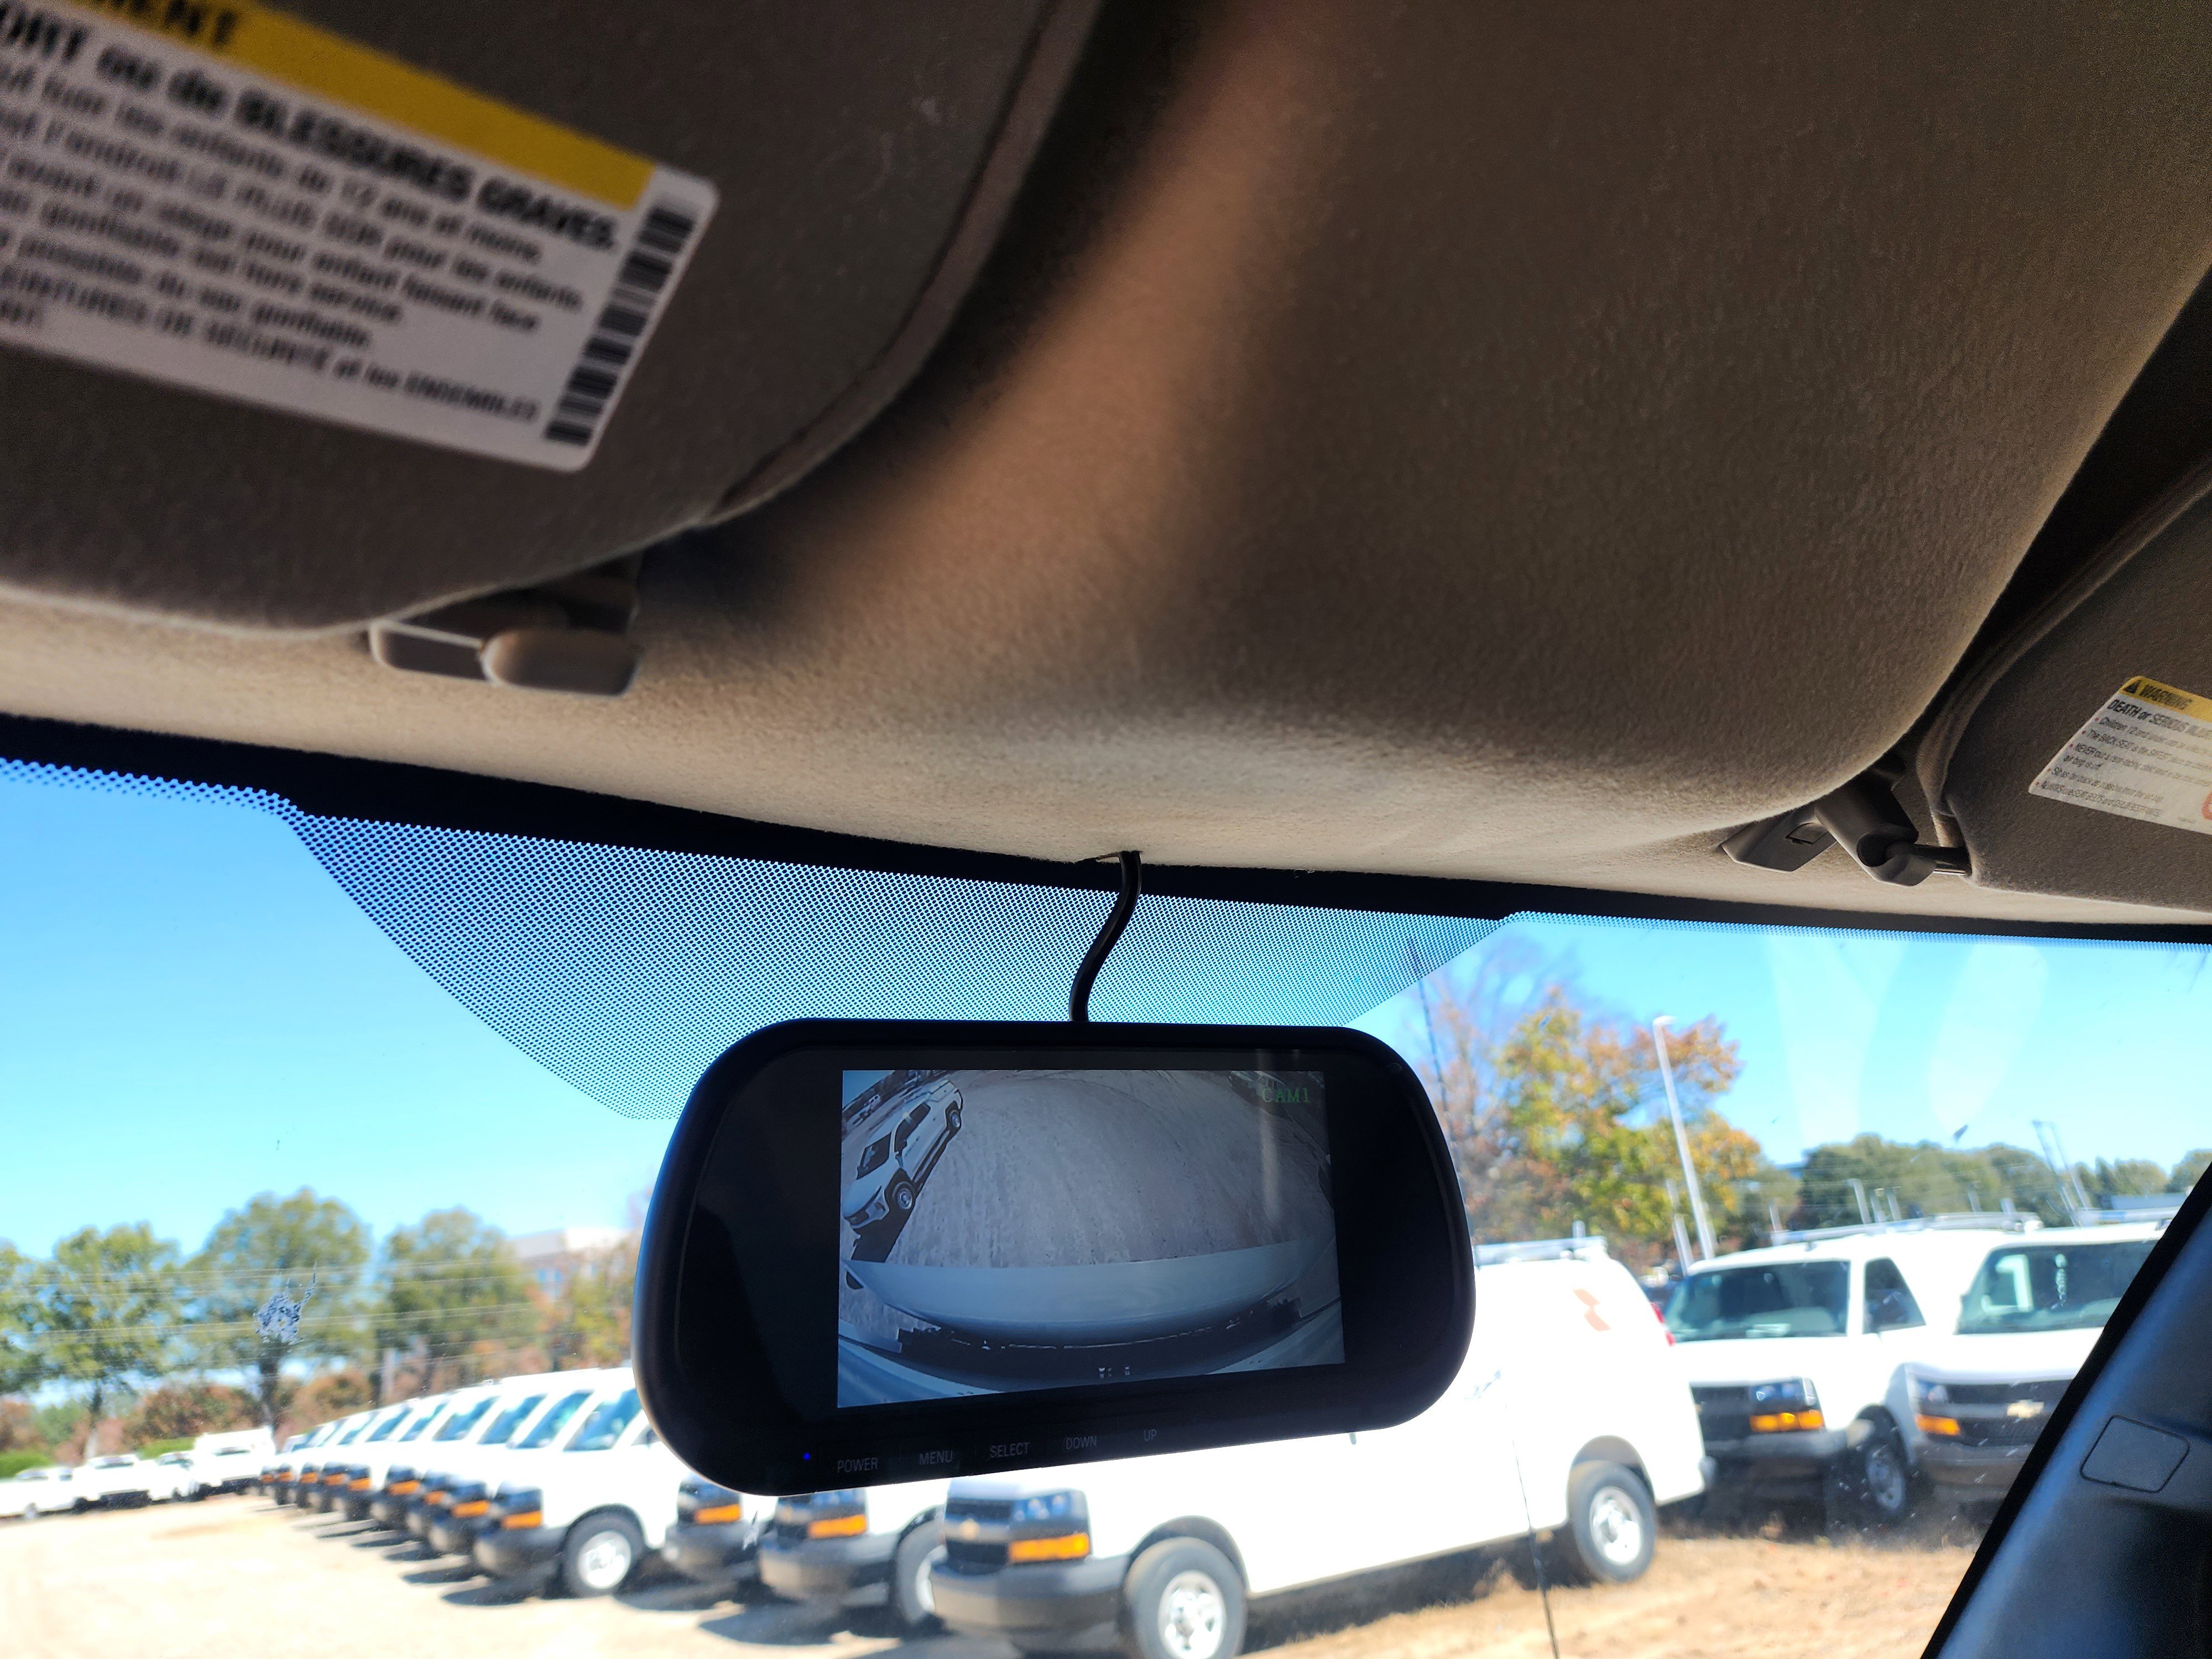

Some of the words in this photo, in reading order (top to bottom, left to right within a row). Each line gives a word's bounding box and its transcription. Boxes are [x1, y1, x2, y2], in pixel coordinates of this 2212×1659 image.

[2107, 699, 2142, 717] DEATH
[2137, 711, 2151, 721] or
[1261, 1087, 1310, 1103] CAM1
[1065, 1435, 1097, 1450] DOWN
[1143, 1428, 1157, 1442] UP
[919, 1450, 953, 1465] MENU
[989, 1442, 1030, 1459] SELECT
[837, 1457, 878, 1473] POWER
